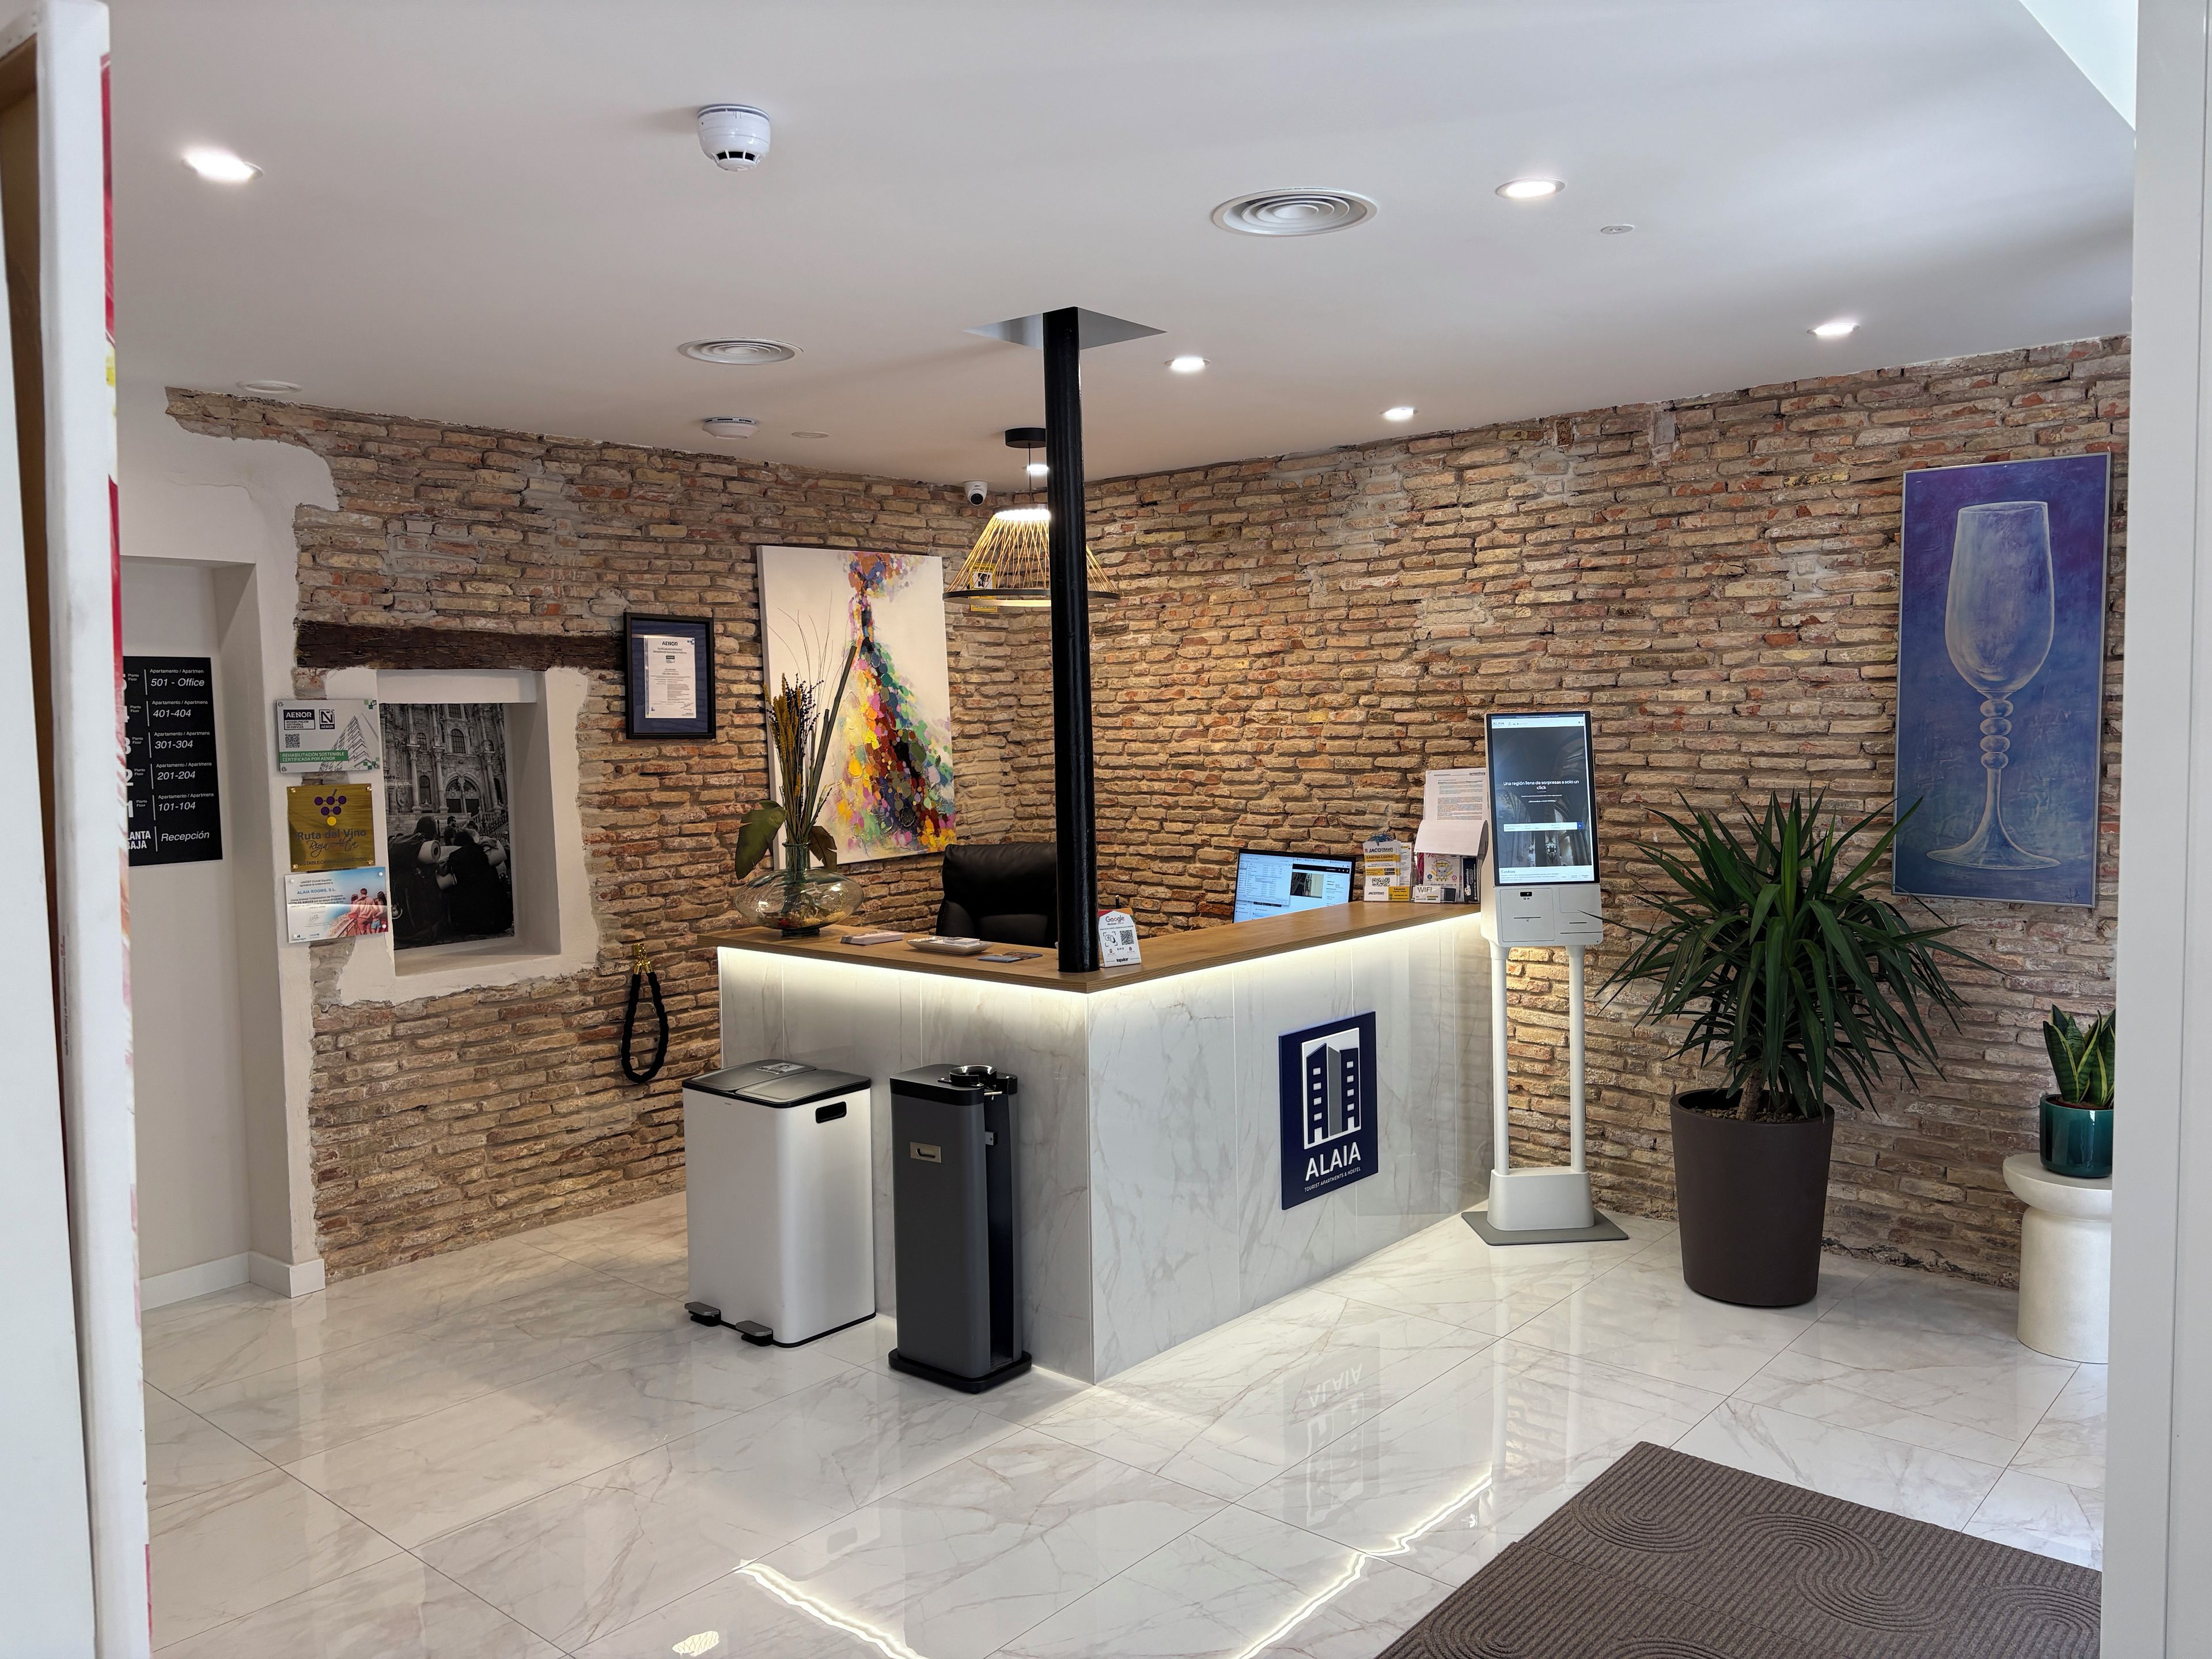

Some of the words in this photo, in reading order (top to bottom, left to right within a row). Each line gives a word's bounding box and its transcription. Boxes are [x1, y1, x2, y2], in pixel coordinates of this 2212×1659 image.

[177, 678, 205, 686] Office
[153, 709, 192, 718] 401-404
[154, 740, 194, 749] 301-304
[157, 771, 196, 780] 201-204
[158, 801, 196, 812] 101-104
[161, 831, 210, 842] Recepción
[297, 832, 321, 840] Ruta
[325, 828, 340, 838] del
[343, 828, 366, 838] Vino
[1105, 915, 1125, 923] Google
[1305, 1142, 1361, 1181] ALAIA
[1304, 1182, 1320, 1192] TOURIST
[1320, 1173, 1344, 1186] APARTMENTS
[1347, 1166, 1361, 1175] HOSTEL
